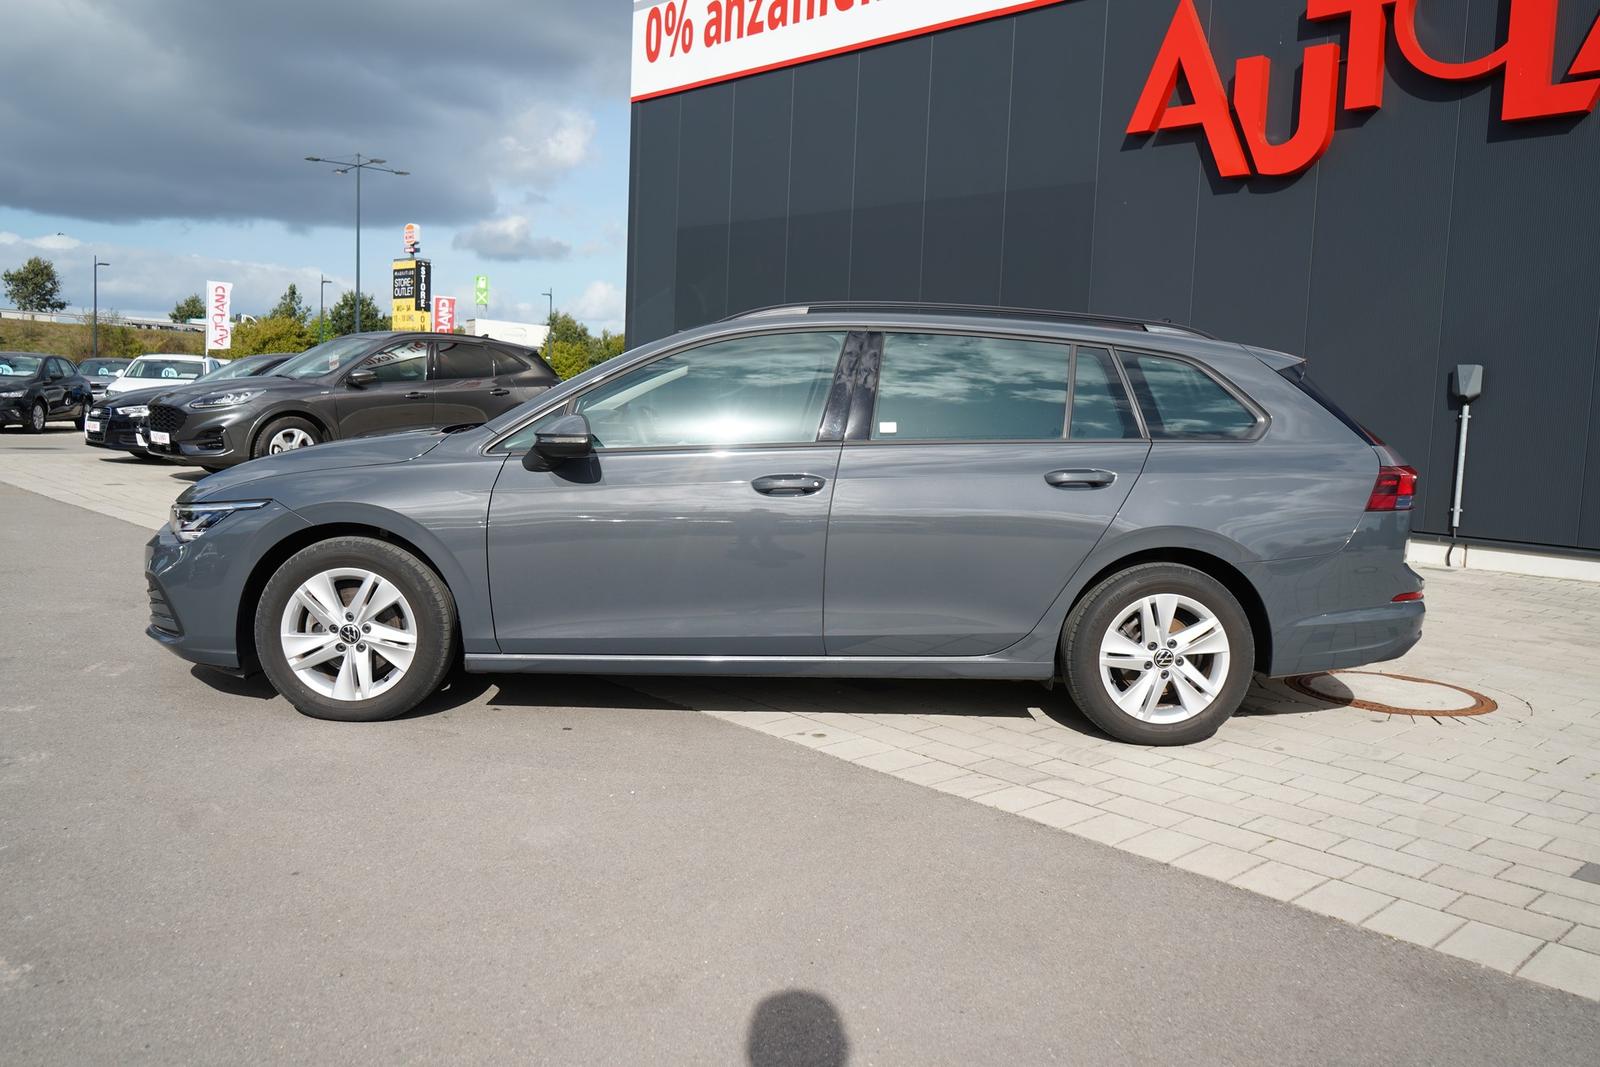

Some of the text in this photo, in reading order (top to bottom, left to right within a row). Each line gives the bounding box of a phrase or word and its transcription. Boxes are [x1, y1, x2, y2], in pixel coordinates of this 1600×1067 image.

[646, 0, 693, 63] 0%
[1126, 0, 1600, 177] AUTOL
[394, 286, 413, 296] OUTLET
